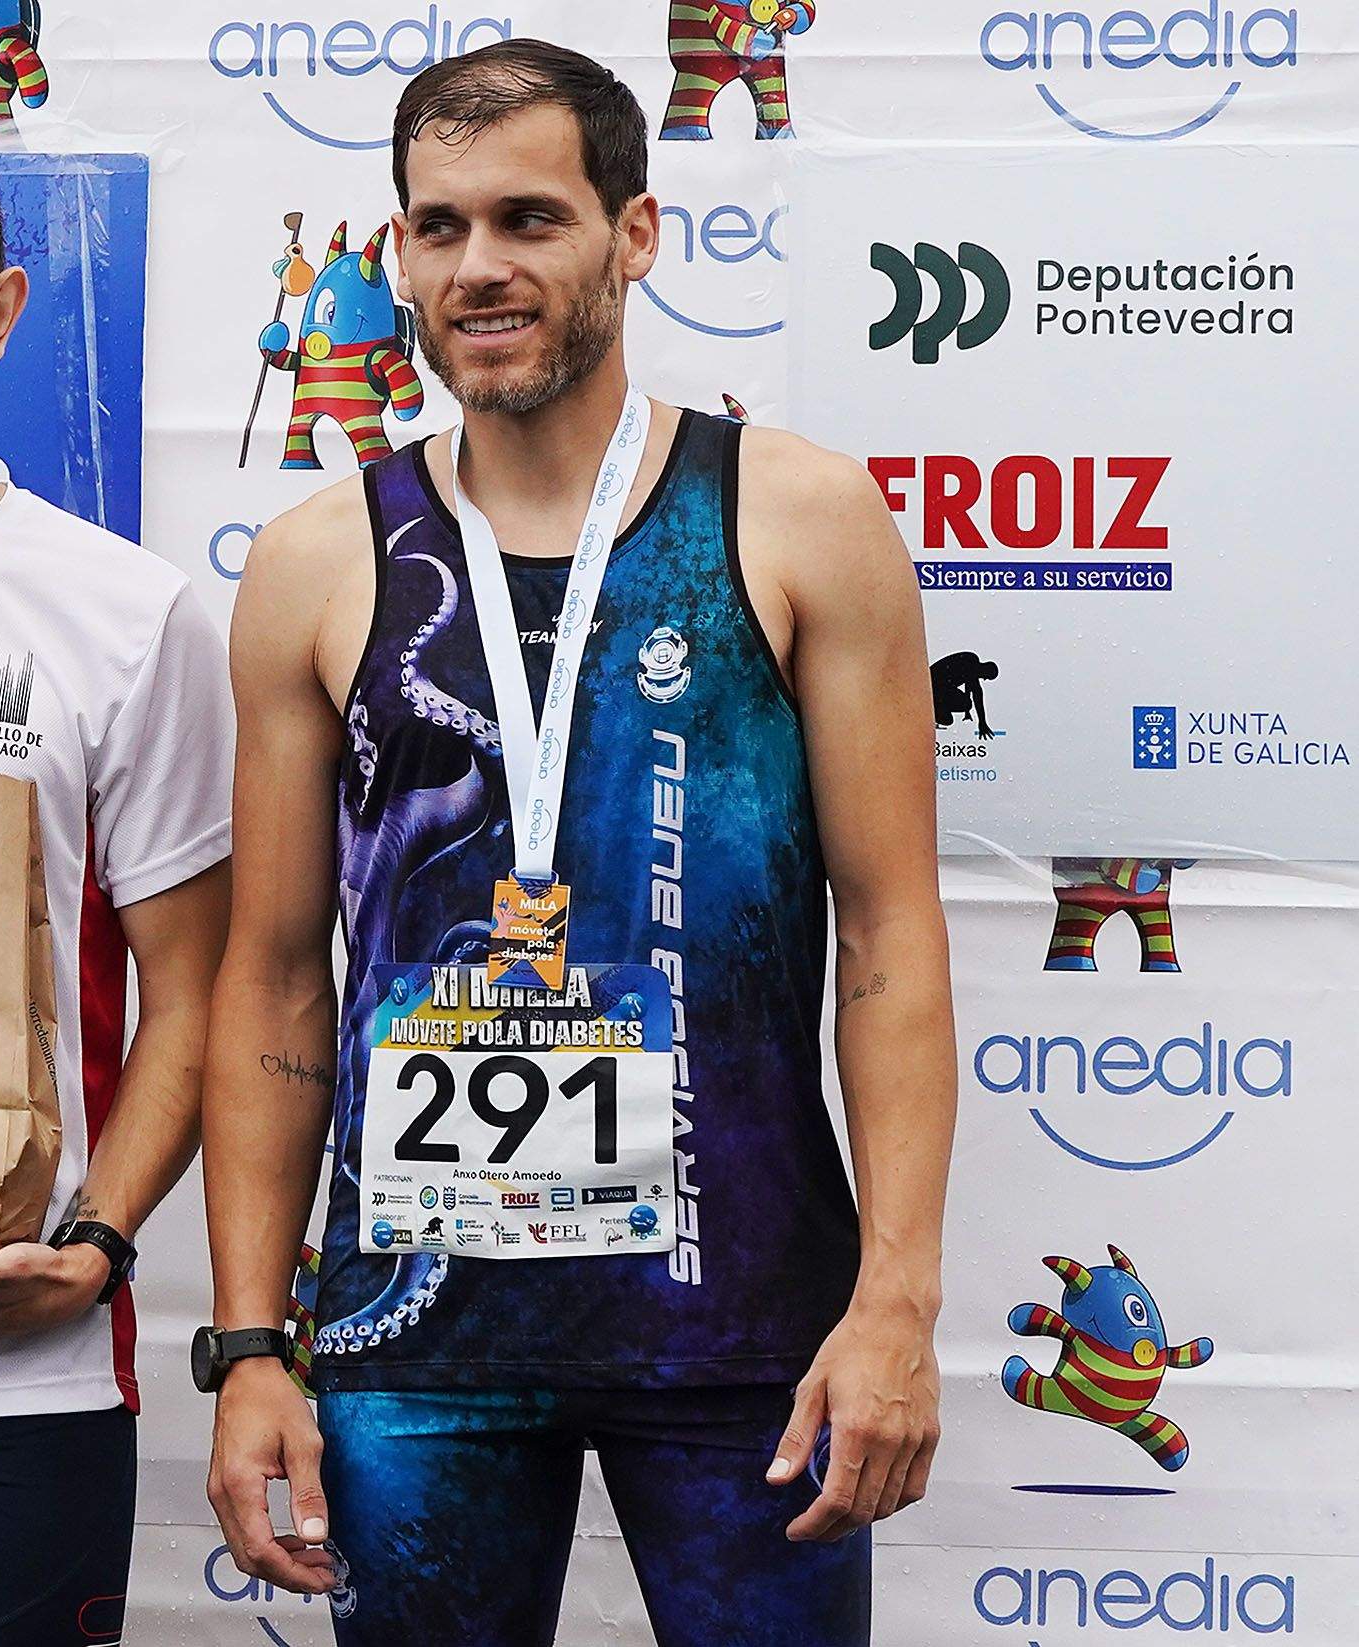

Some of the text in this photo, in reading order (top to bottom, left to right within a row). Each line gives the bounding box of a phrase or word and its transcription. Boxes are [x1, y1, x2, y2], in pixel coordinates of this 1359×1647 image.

[979, 0, 1297, 72] anedia
[1037, 252, 1294, 301] Deputación
[1037, 301, 1294, 335] Pontevedra
[595, 462, 617, 507] anedia
[867, 455, 1173, 550] FROIZ
[577, 523, 597, 571] anedia
[921, 564, 1168, 590] Siempre a su servicio
[562, 589, 580, 639] anedia
[549, 658, 565, 709] anedia
[26, 731, 43, 748] DE
[1188, 712, 1288, 736] XUNTA
[538, 728, 554, 780] anedia
[934, 765, 997, 782] letismo
[1188, 742, 1350, 766] DE GALICIA
[528, 799, 543, 852] anedia
[651, 729, 686, 930] BUEU
[519, 898, 557, 911] MILLA
[510, 925, 556, 937] móvete
[527, 940, 555, 951] pola
[502, 946, 554, 961] diabetes
[431, 967, 459, 1008] XI
[391, 1015, 643, 1046] MÓVETE POLA DIABETES
[974, 1022, 1293, 1096] anedia
[394, 1053, 618, 1165] 291
[453, 1169, 562, 1181] Anxo Otero Amoedo
[501, 1192, 540, 1205] FROIZ
[974, 1557, 1294, 1632] anedia
